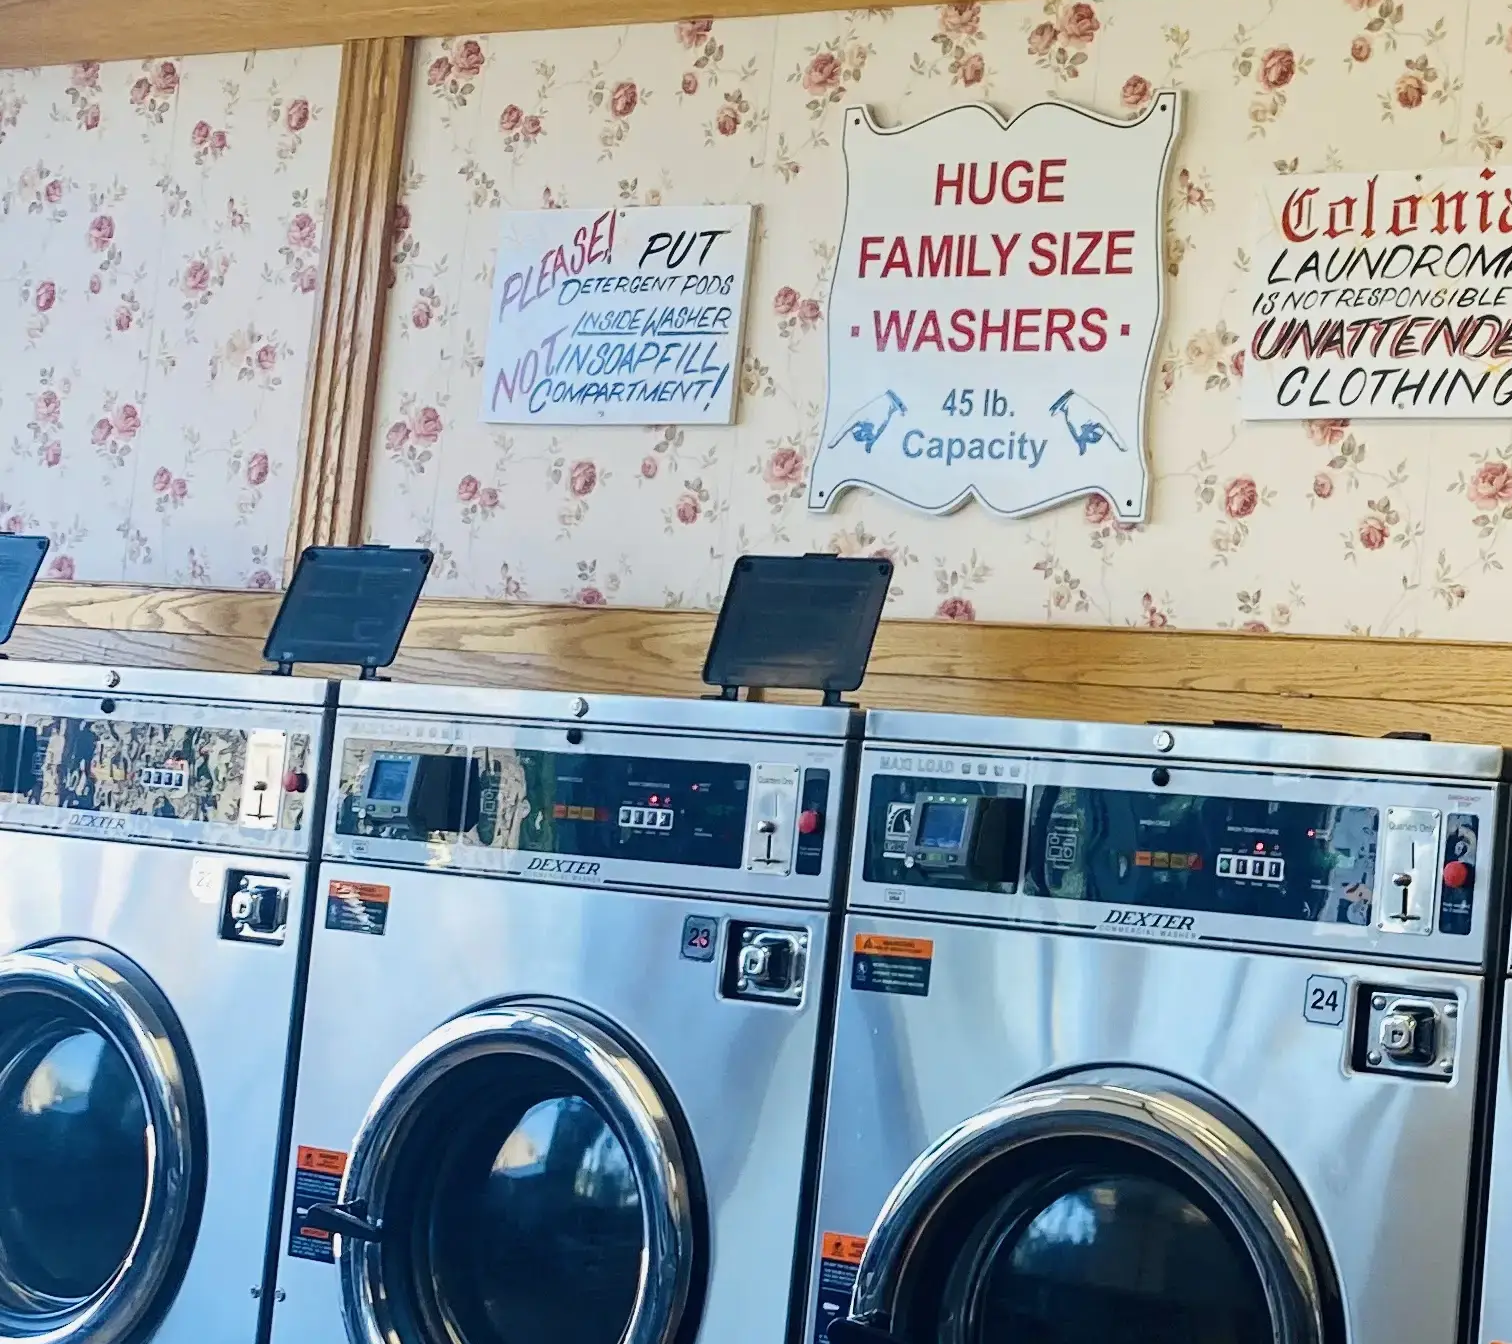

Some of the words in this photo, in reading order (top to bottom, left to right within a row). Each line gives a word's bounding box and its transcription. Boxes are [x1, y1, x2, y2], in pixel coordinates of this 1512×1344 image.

[934, 158, 1067, 206] HUGE
[638, 230, 731, 269] PUT
[857, 232, 1021, 280] FAMILY
[1028, 229, 1136, 276] SIZE
[558, 275, 682, 306] DETERGENT
[680, 274, 734, 296] PODS
[1252, 290, 1279, 318] IS
[1281, 287, 1341, 312] NOT
[571, 310, 641, 338] INSIDE
[641, 306, 732, 338] WASHER
[873, 307, 1110, 354] WASHERS
[491, 326, 569, 413] NOT
[528, 362, 730, 414] COMPARTMENT!
[941, 388, 976, 418] 45
[983, 388, 1015, 418] lb.
[902, 429, 1048, 468] Capacity
[527, 857, 601, 876] DEXTER
[1103, 909, 1195, 931] DEXTER
[688, 927, 711, 949] 23
[1310, 987, 1339, 1012] 24
